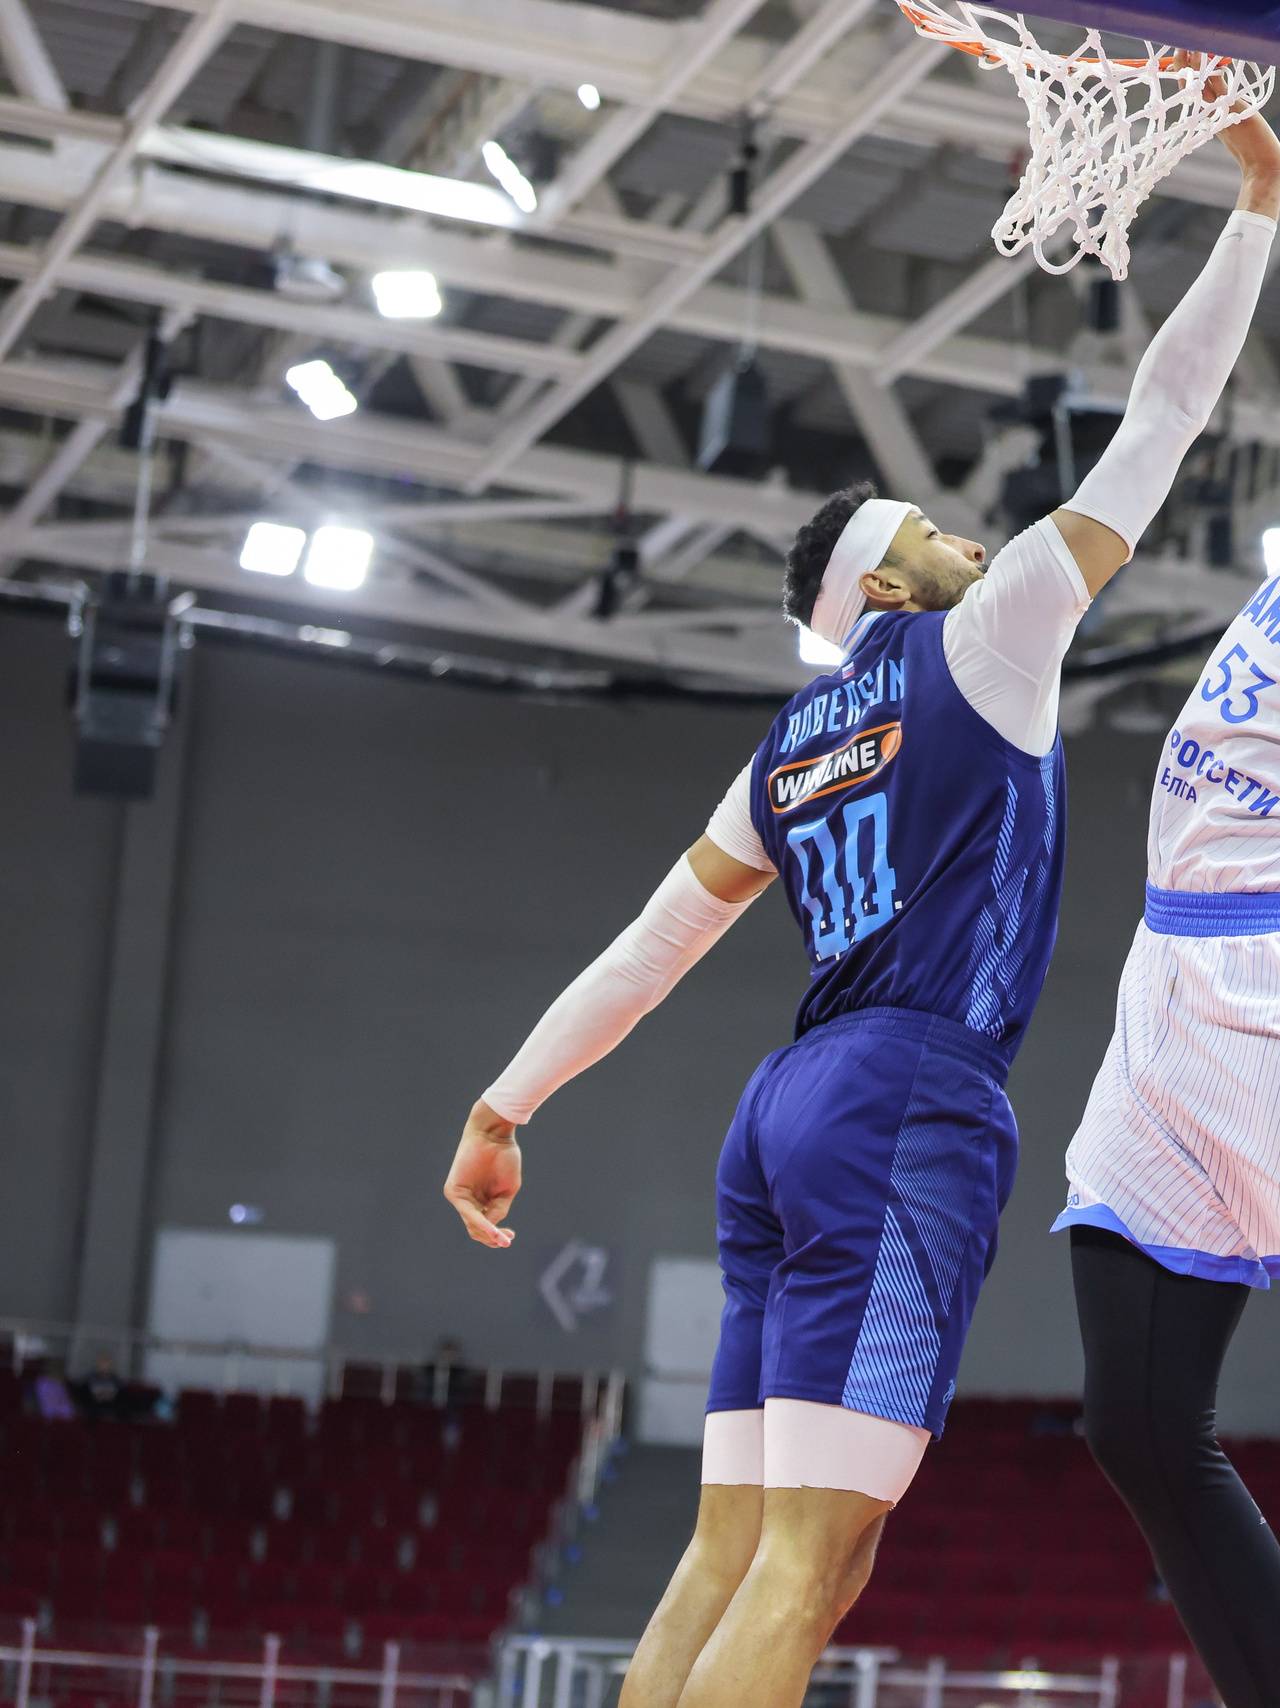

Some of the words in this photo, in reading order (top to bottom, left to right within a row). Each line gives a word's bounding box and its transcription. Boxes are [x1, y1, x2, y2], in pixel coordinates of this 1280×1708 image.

[1202, 643, 1277, 724] 53
[777, 740, 876, 803] WINLINE
[787, 792, 897, 960] 00
